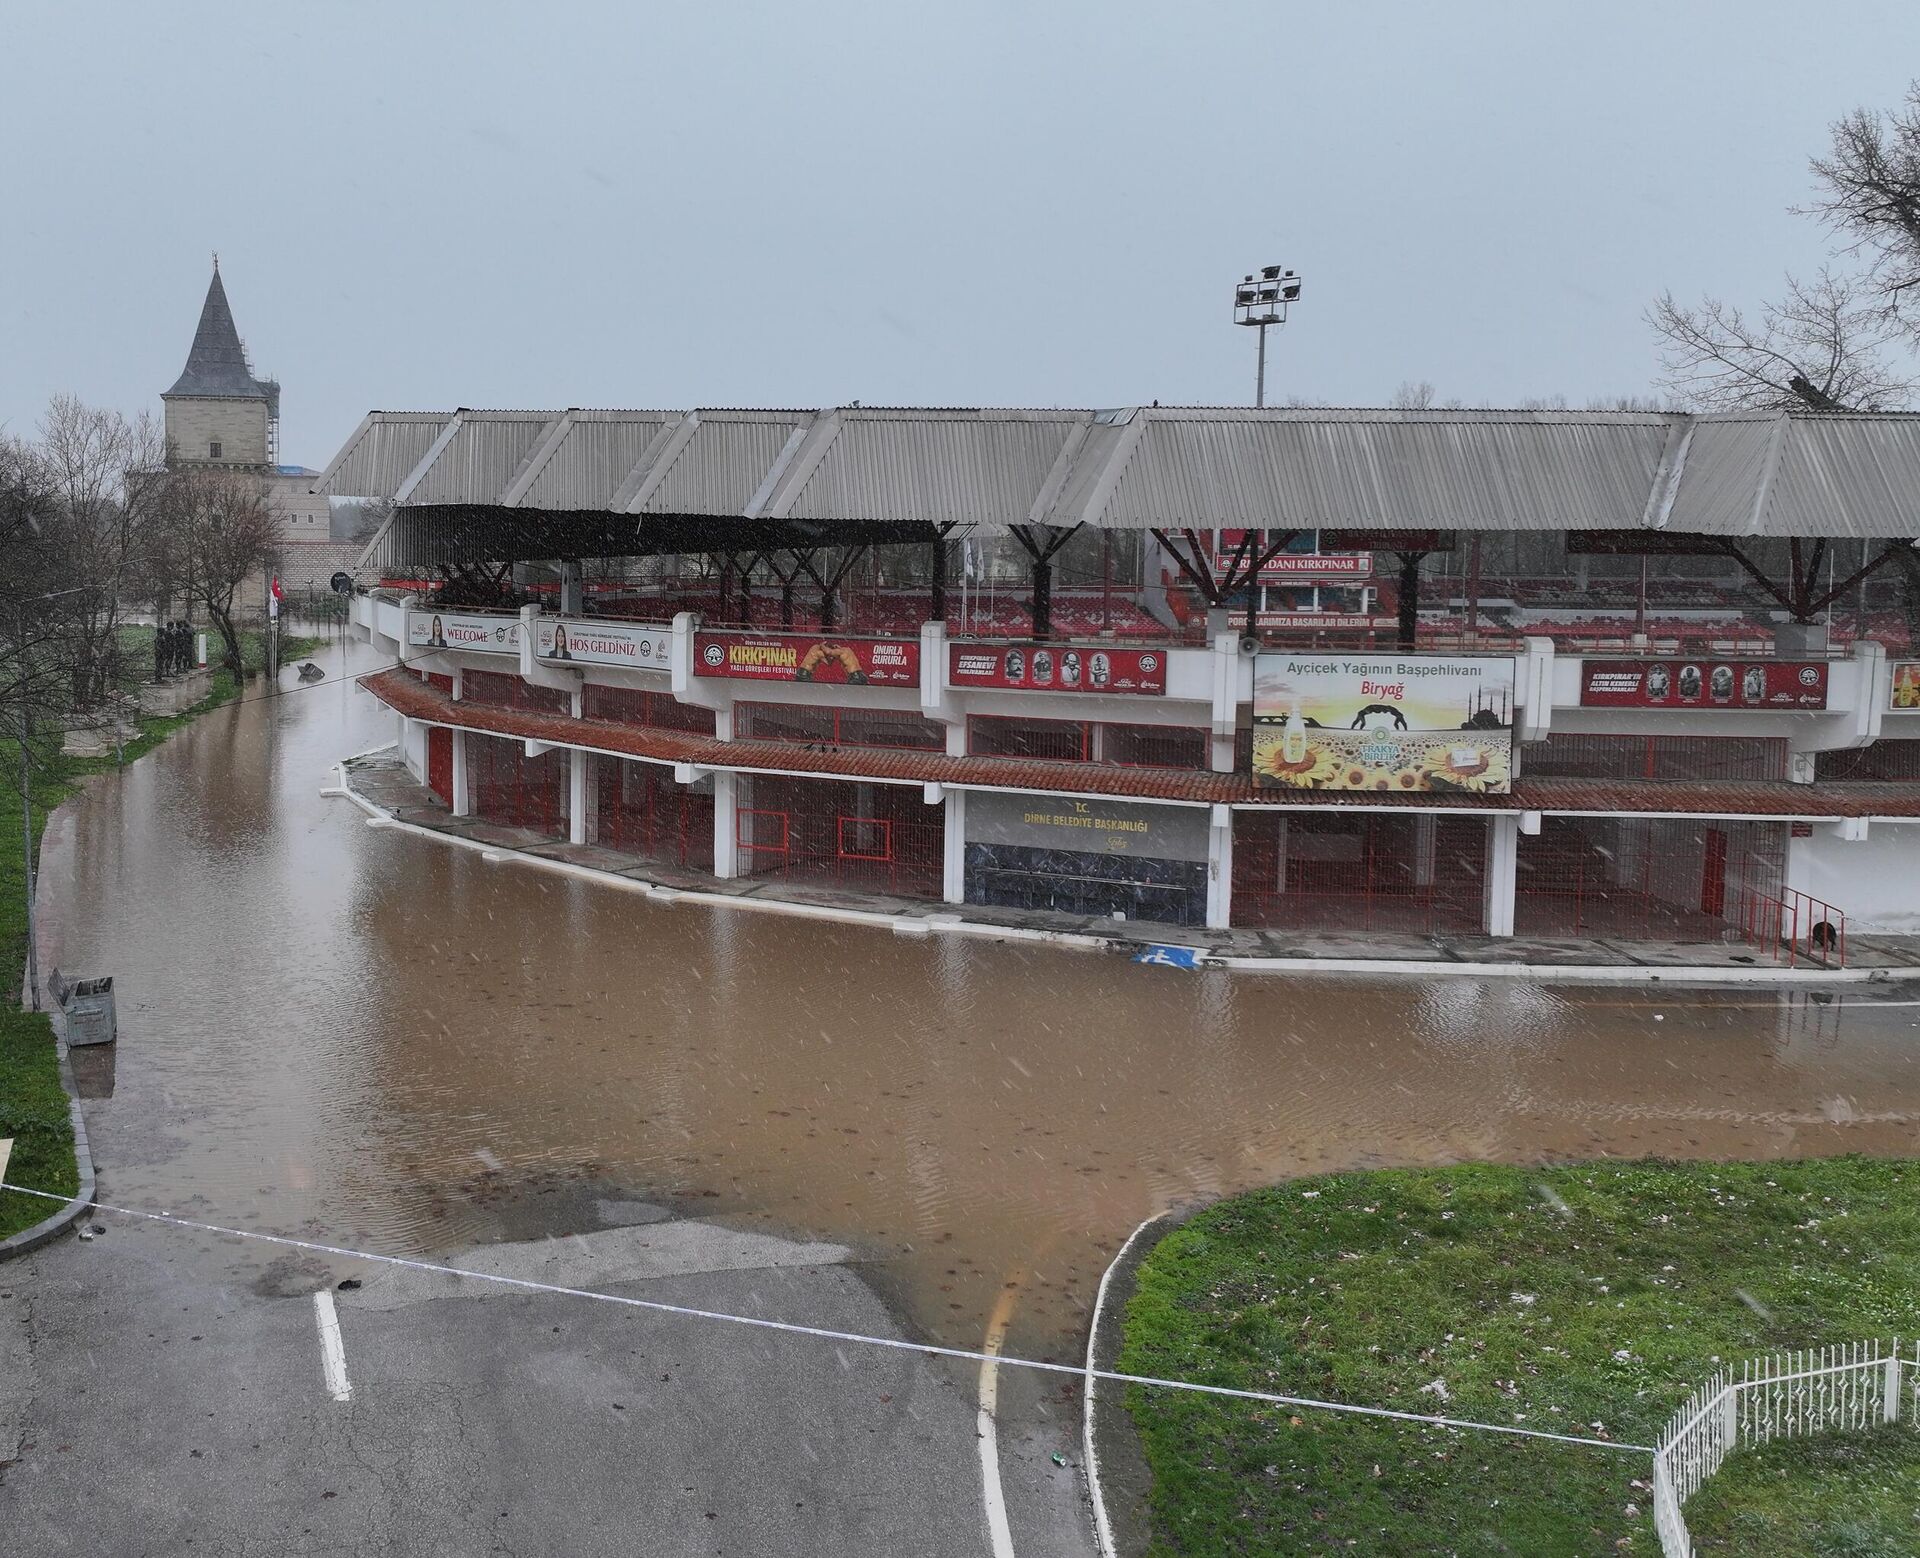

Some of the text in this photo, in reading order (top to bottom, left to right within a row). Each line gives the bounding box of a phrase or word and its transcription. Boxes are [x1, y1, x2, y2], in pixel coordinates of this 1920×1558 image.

[1298, 560, 1354, 569] KIRKPINAR
[1293, 617, 1336, 627] BAŞARILAR
[447, 628, 488, 643] WELCOME
[569, 638, 589, 654] HOŞ
[590, 640, 636, 656] GELDİNİZ
[873, 645, 903, 656] ONURLA
[729, 645, 797, 667] KIRKPINAR
[872, 655, 907, 666] GURURLA
[730, 664, 745, 672] YAĞLI
[1287, 662, 1482, 678] Ayçiçek Yağının Başpehlivanı
[1361, 681, 1405, 701] Biryağ
[1360, 745, 1400, 753] TRAKYA
[1075, 802, 1091, 813] T.C.
[1053, 814, 1092, 828] BELEDİYE
[1094, 817, 1148, 833] BAŞKANLIĞI
